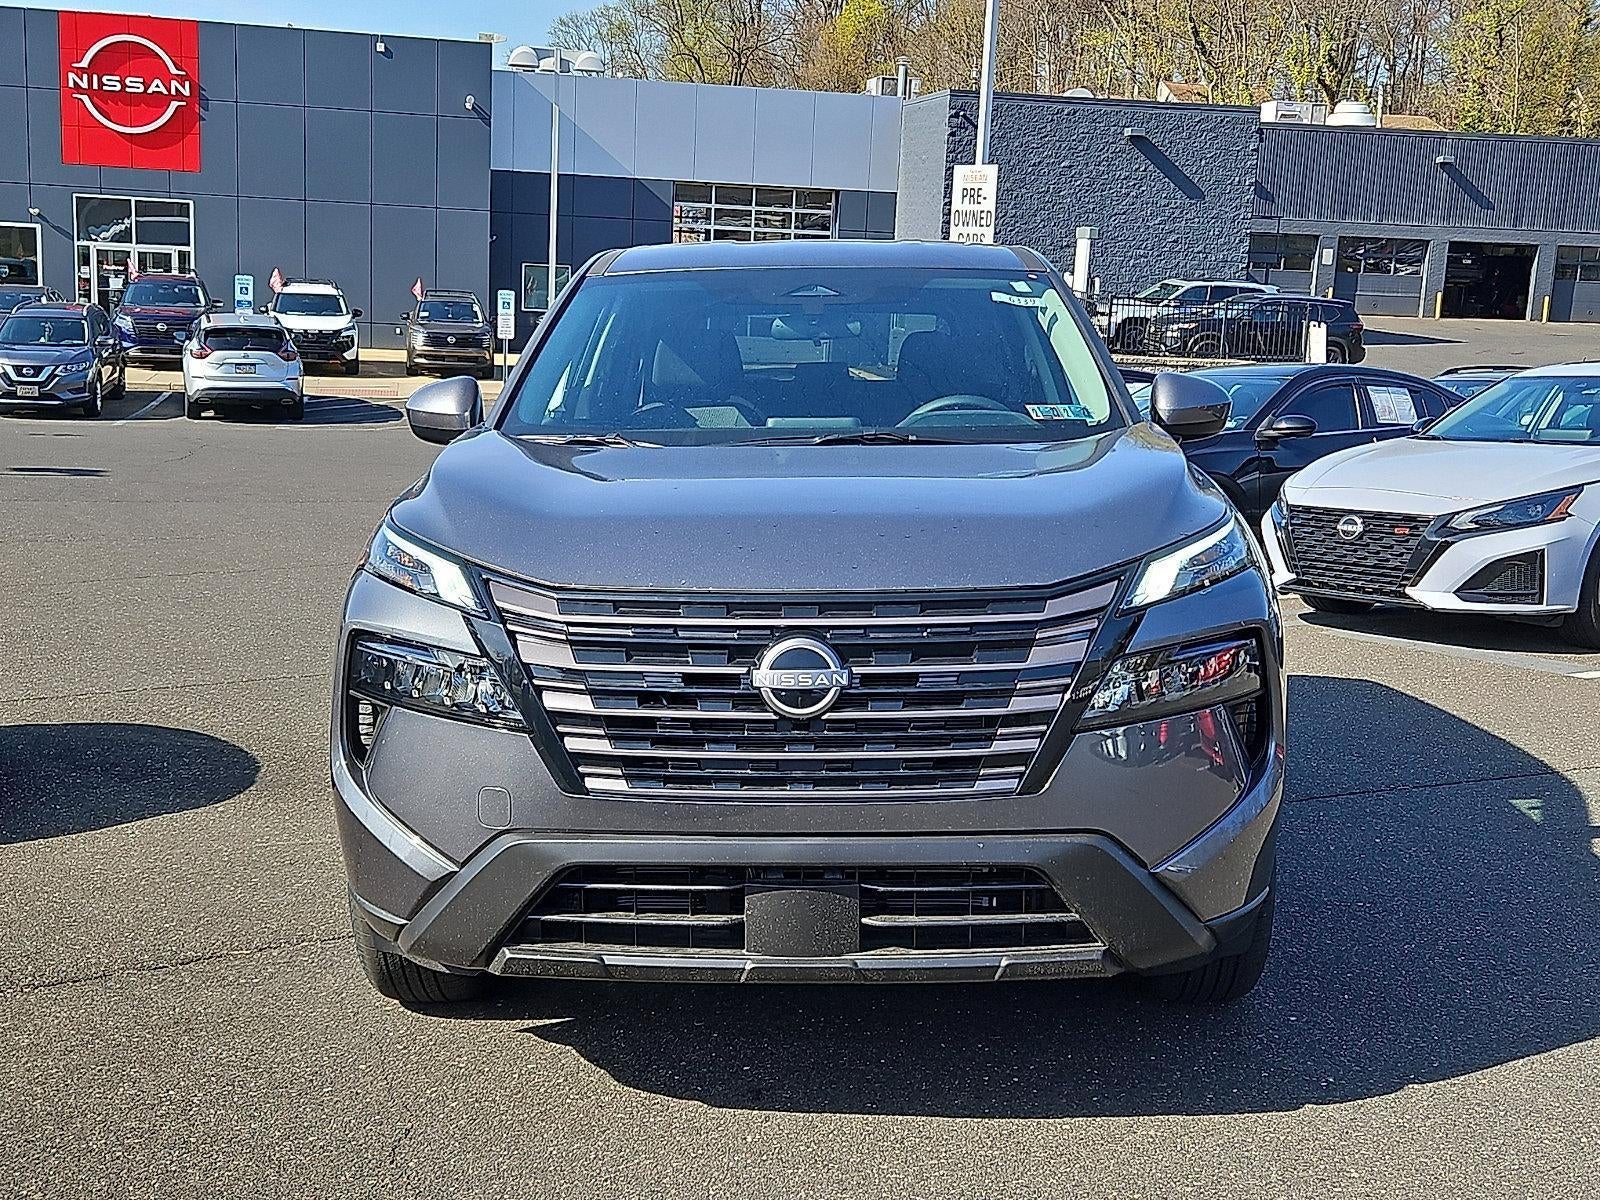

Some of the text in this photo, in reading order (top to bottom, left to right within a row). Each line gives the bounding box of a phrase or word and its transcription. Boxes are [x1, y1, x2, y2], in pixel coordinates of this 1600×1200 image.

[67, 71, 191, 97] NISSAN
[961, 187, 988, 205] PRE-
[953, 209, 993, 228] OWNED
[754, 672, 848, 686] NISSAN
